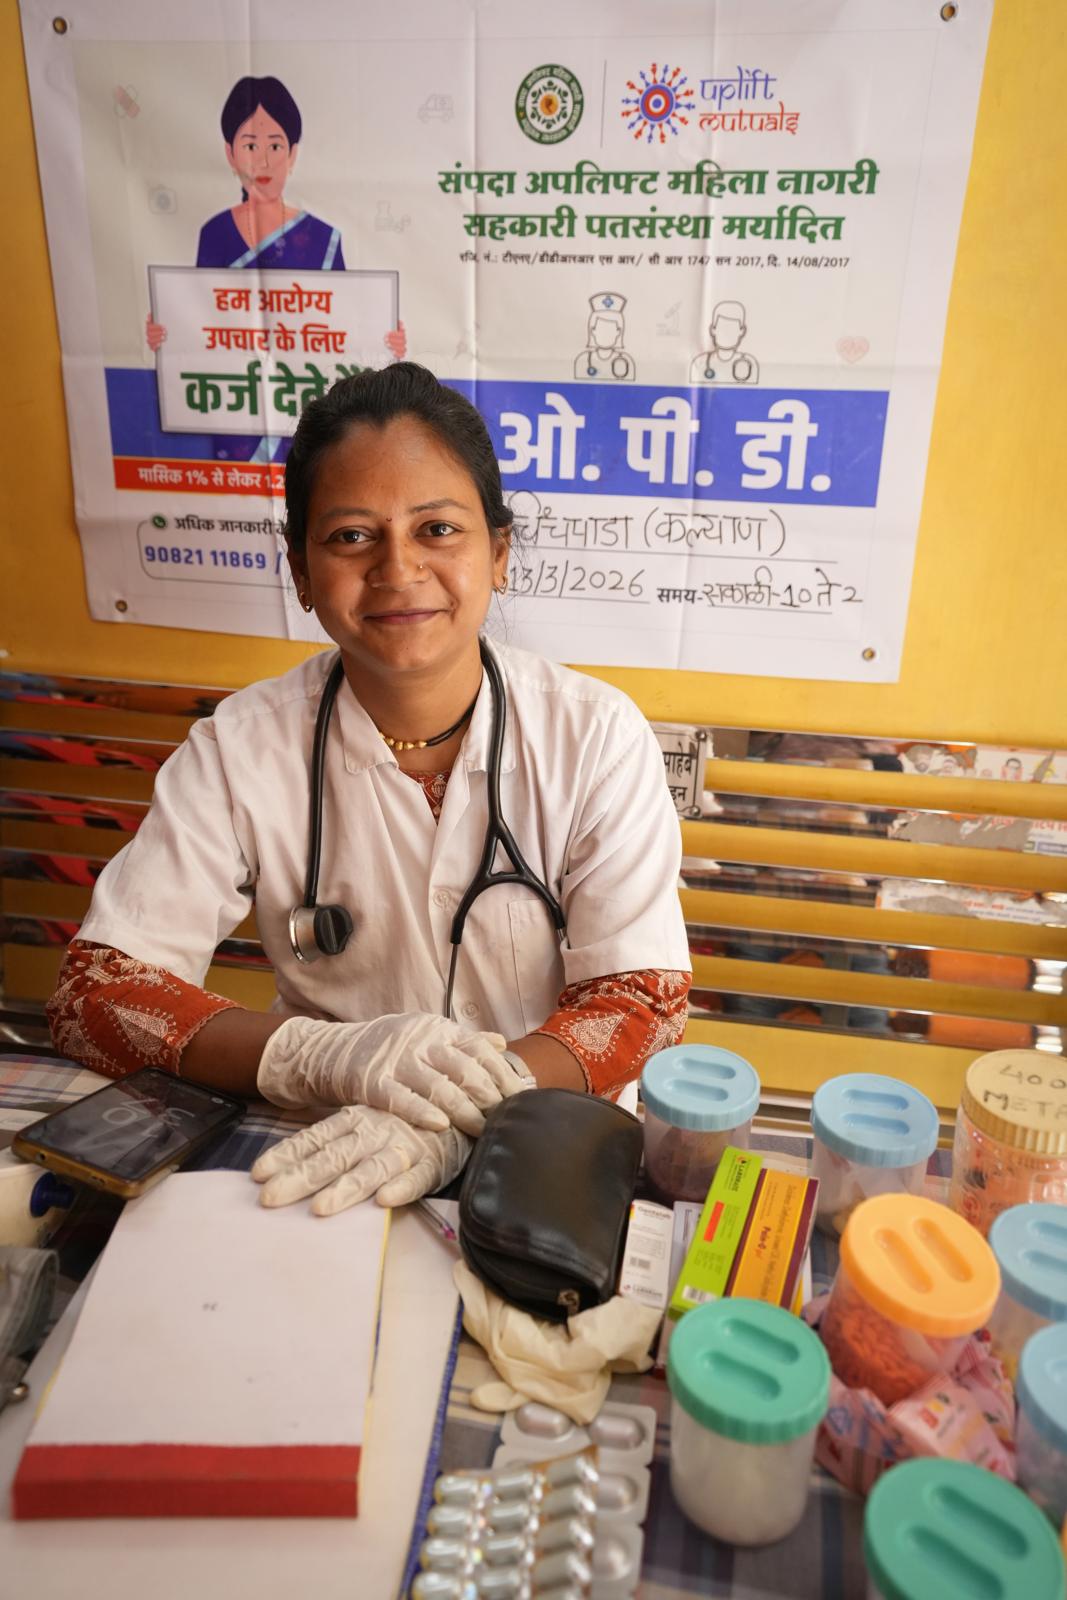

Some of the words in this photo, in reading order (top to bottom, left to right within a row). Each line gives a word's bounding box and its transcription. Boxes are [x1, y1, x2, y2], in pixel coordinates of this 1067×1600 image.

[699, 65, 777, 111] uplift
[699, 101, 800, 135] mutuals
[437, 162, 516, 197] संपदा
[525, 160, 660, 195] अपलिफ्ट
[667, 159, 769, 198] महिला
[777, 158, 880, 195] नागरी
[463, 204, 578, 241] सहकारी
[585, 205, 714, 240] पतसंस्था
[722, 204, 846, 244] मर्यादित
[735, 256, 764, 268] 2017,
[787, 256, 850, 269] 14/08/2017
[212, 288, 251, 312] हम
[258, 282, 334, 314] आरोग्य
[202, 326, 270, 351] उपचार
[273, 322, 297, 352] के
[301, 323, 347, 354] लिए
[180, 360, 262, 416] कर्ज
[498, 391, 601, 482] ओ.
[619, 396, 715, 487] पी.
[735, 398, 832, 493] डी.
[138, 464, 183, 485] मासिक
[186, 470, 209, 486] 1%
[211, 467, 225, 486] से
[228, 468, 262, 488] लेकर
[174, 514, 215, 531] अधिक
[219, 518, 273, 536] जानकारी
[643, 506, 787, 557] (कल्याण)
[144, 545, 204, 566] 90821
[209, 550, 267, 570] 11869
[509, 559, 646, 598] 13/3/2026
